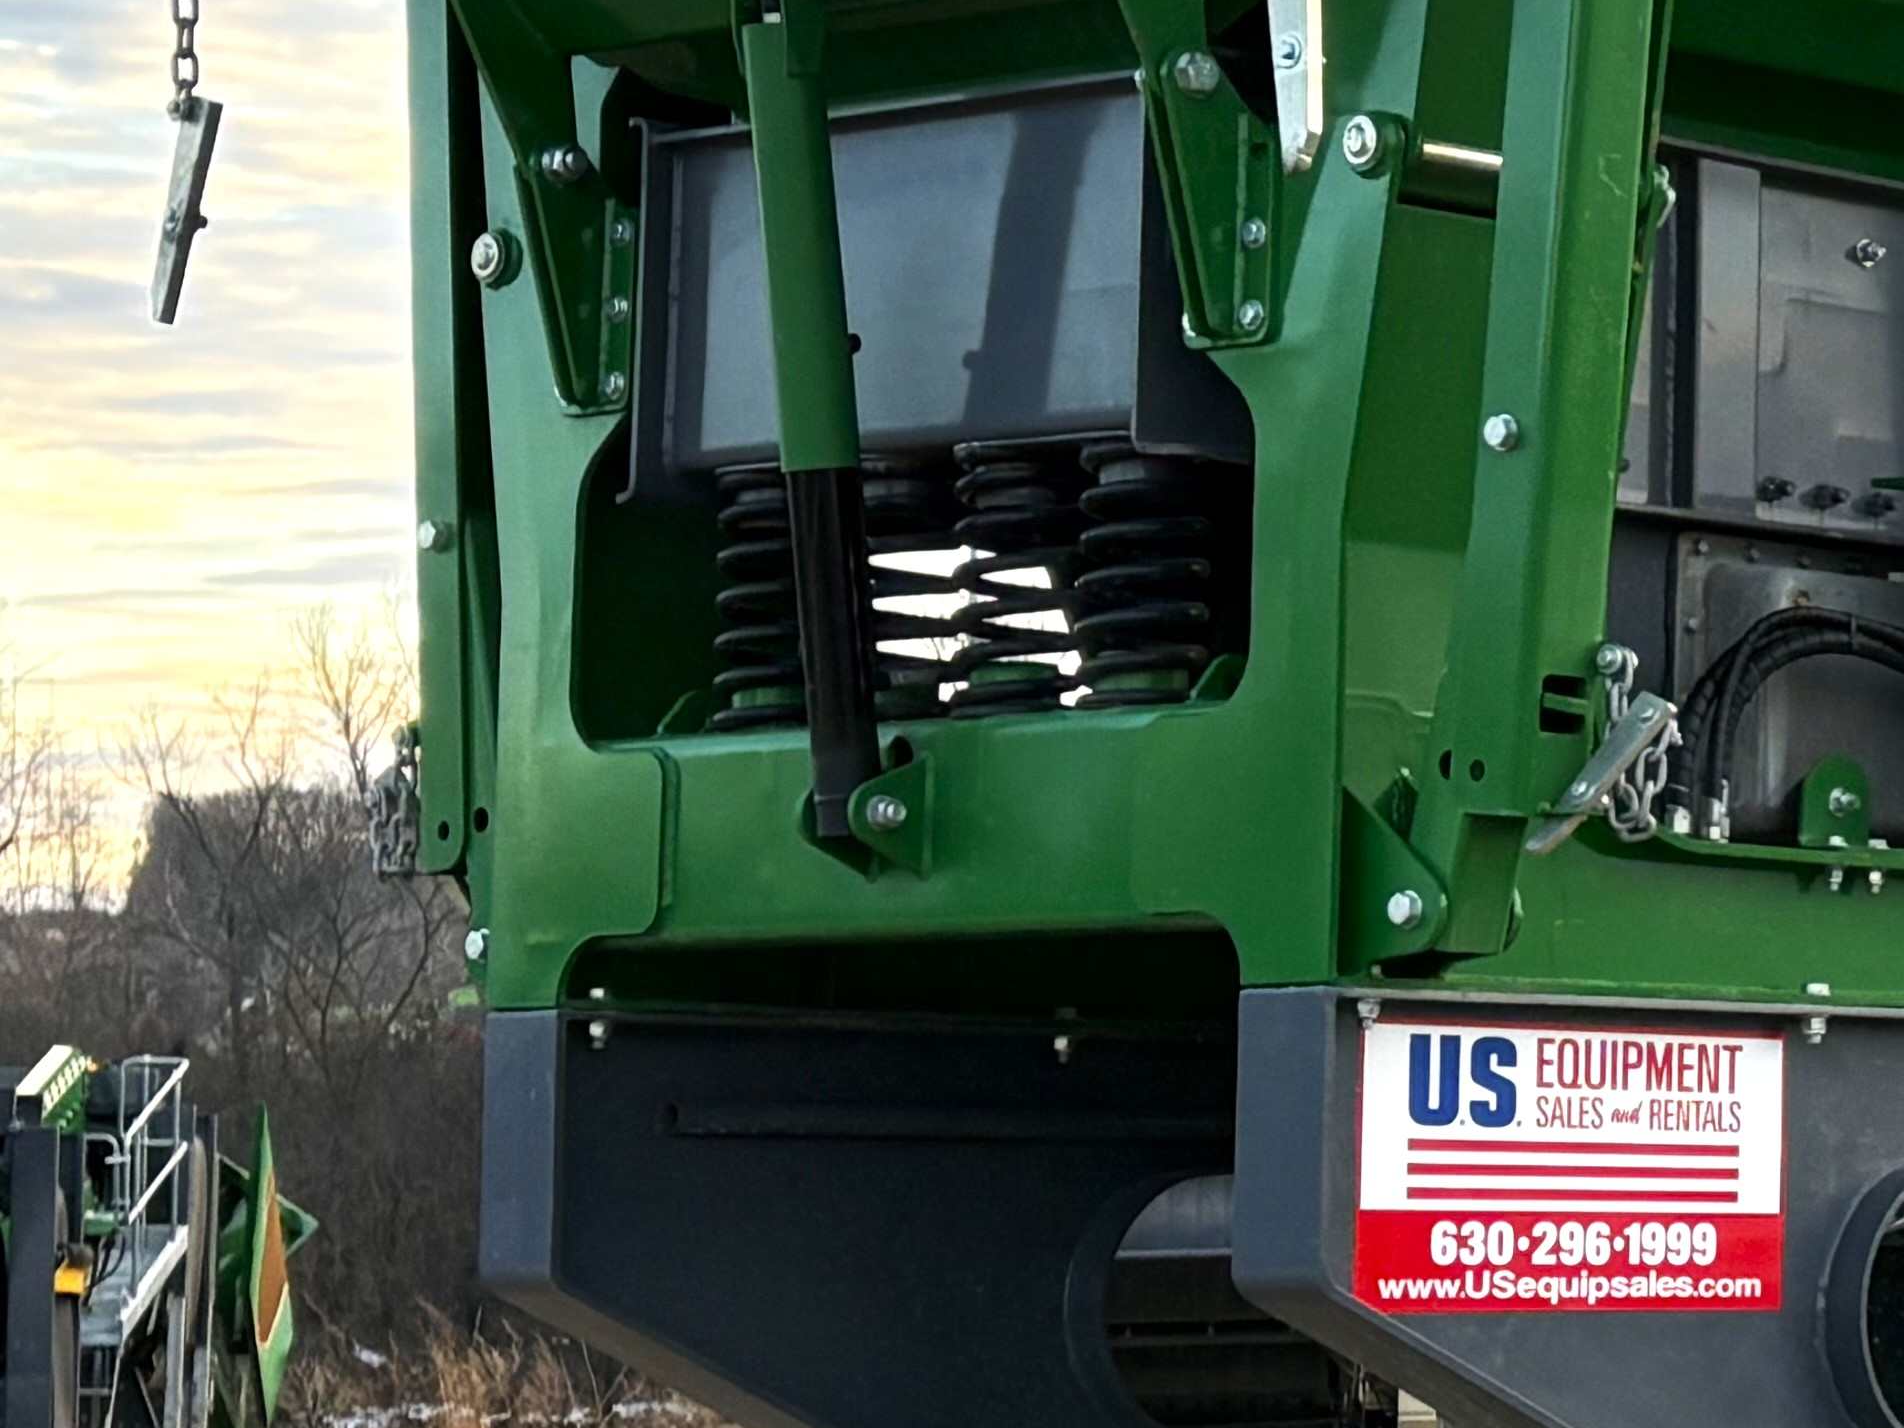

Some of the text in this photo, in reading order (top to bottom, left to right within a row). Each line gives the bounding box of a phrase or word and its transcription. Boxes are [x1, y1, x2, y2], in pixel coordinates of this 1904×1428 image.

[1408, 1033, 1744, 1129] U.S. EQUIPMENT
[1536, 1096, 1742, 1134] SALES and RENTALS
[1377, 1270, 1762, 1304] www.USequipsales.com
